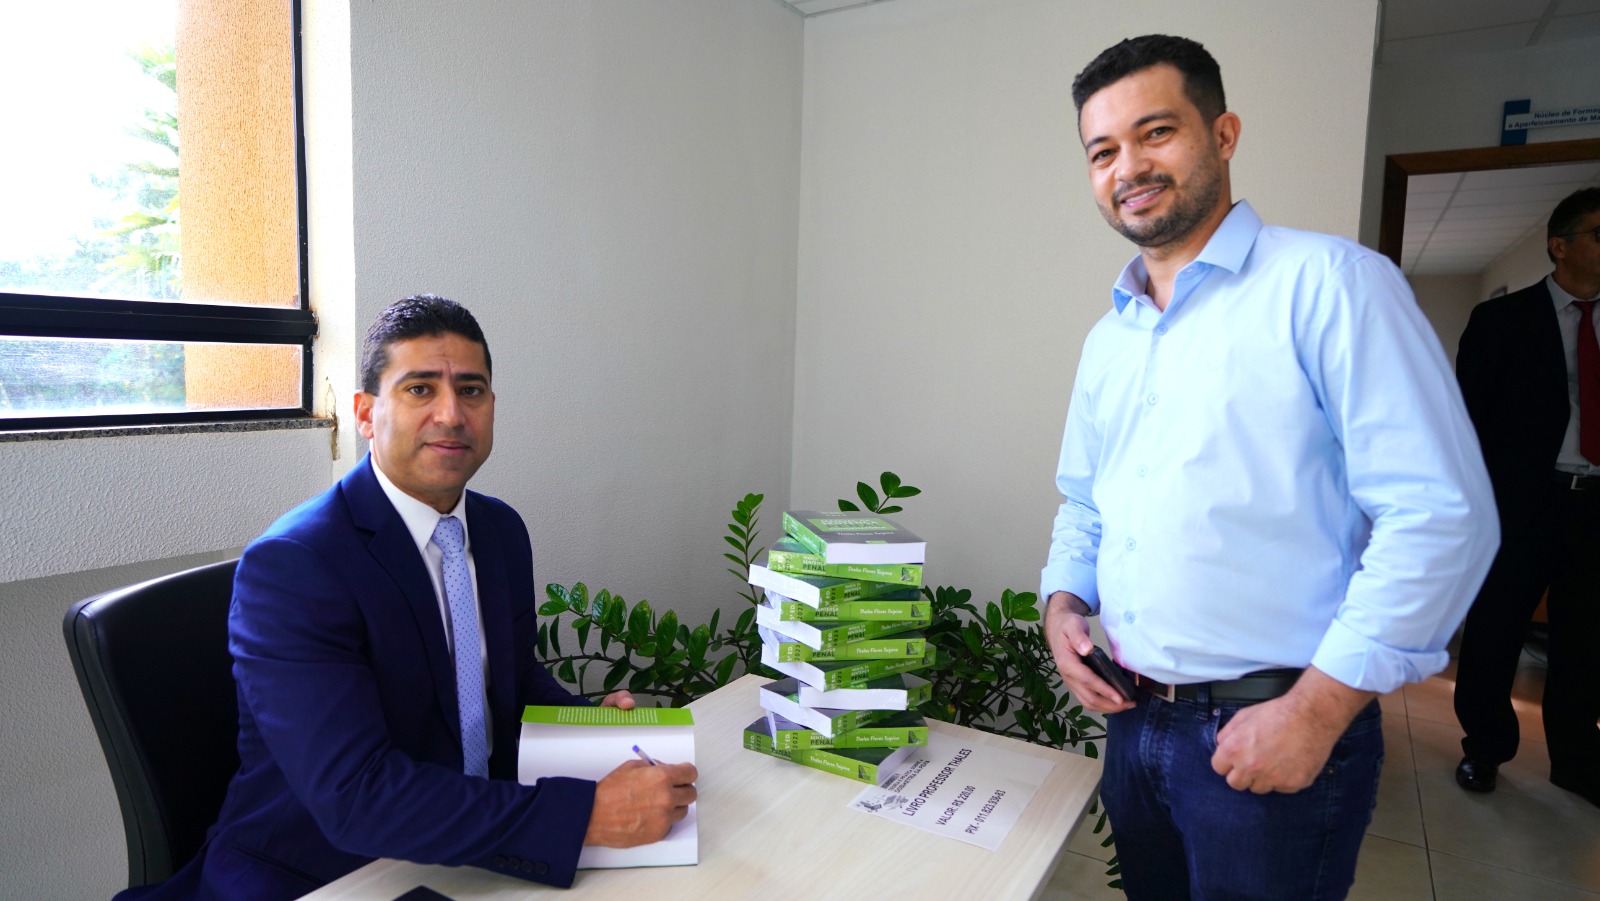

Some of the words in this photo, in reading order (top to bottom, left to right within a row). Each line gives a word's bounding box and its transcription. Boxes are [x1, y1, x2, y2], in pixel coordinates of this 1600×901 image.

[844, 591, 860, 599] PENAL
[902, 798, 926, 816] LIVRO
[919, 766, 956, 798] PROFESSOR
[948, 748, 972, 767] THALES
[935, 806, 958, 825] VALOR:
[952, 799, 964, 807] R$
[965, 824, 979, 834] PIX
